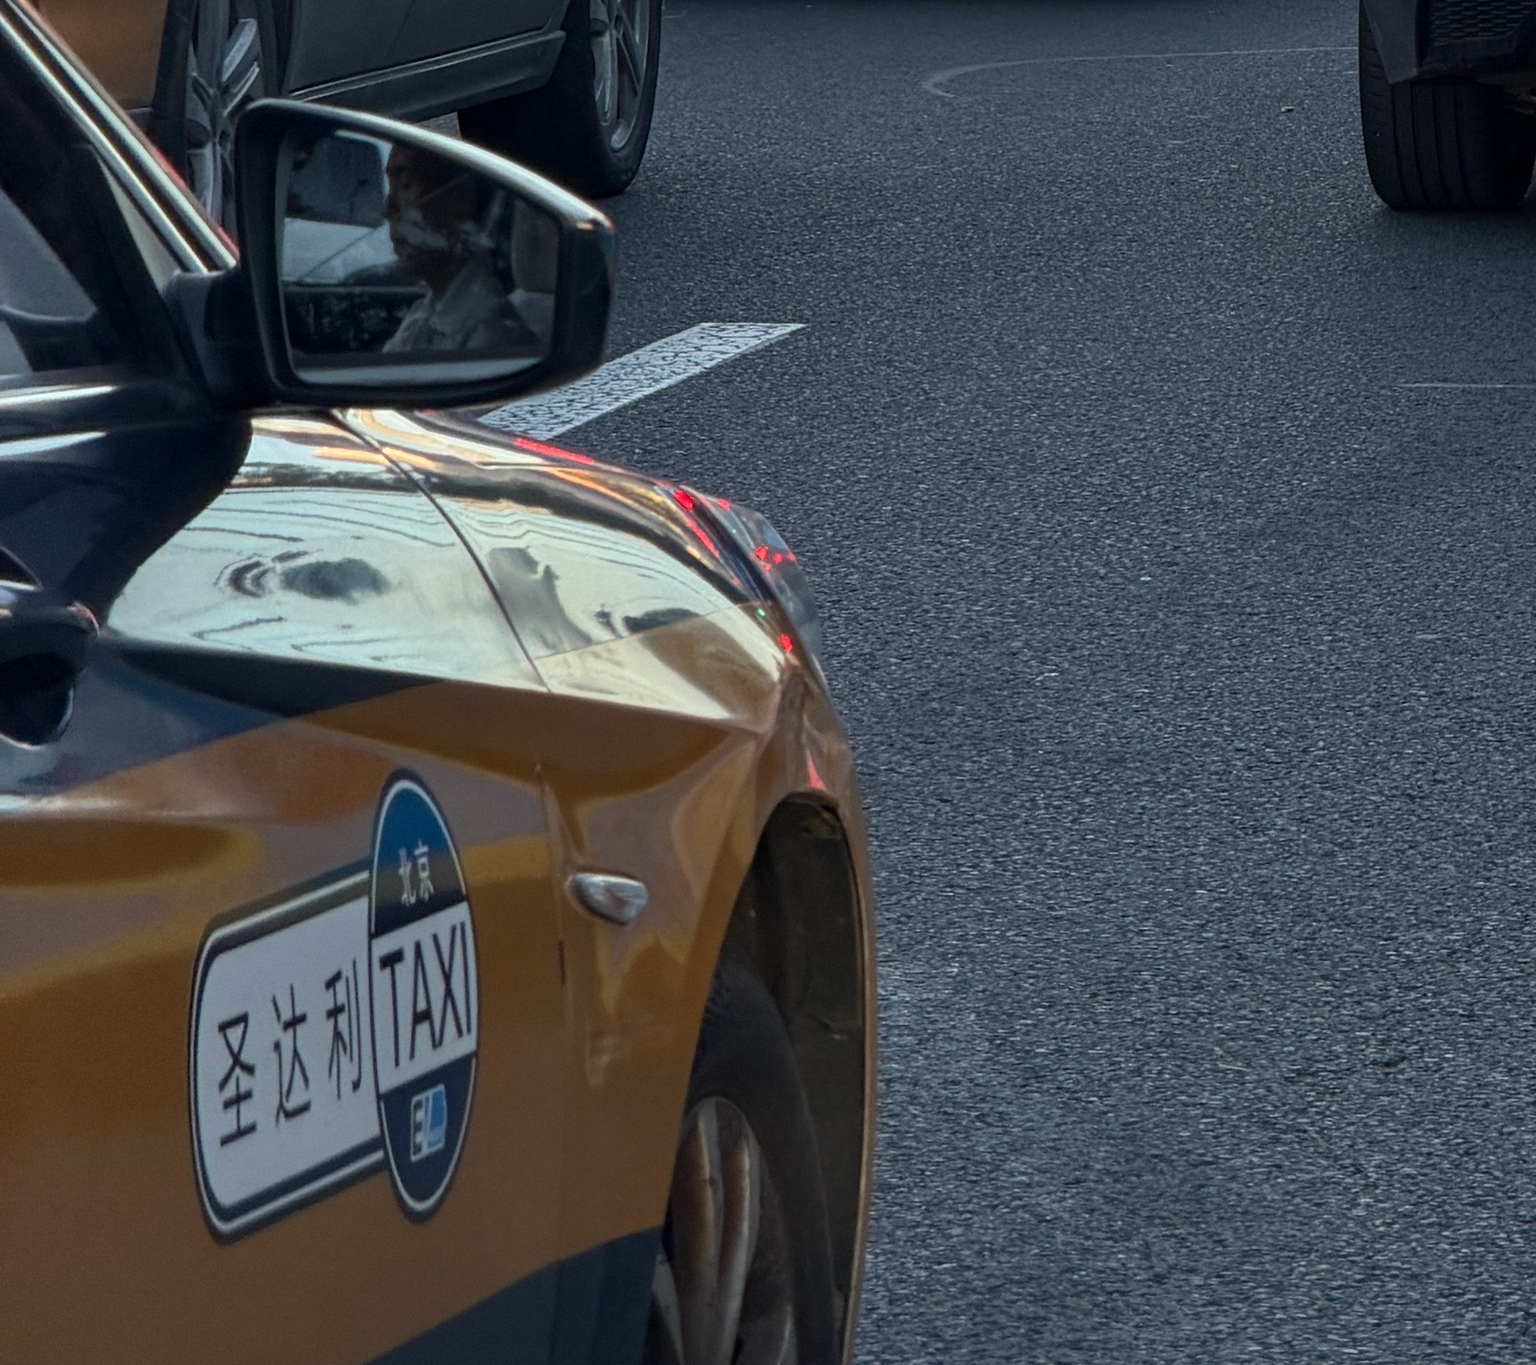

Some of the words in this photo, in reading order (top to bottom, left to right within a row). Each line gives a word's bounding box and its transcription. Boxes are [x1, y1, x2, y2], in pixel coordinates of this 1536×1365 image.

[398, 839, 437, 906] 北京
[217, 957, 363, 1148] 圣达利
[378, 920, 472, 1069] TAXI
